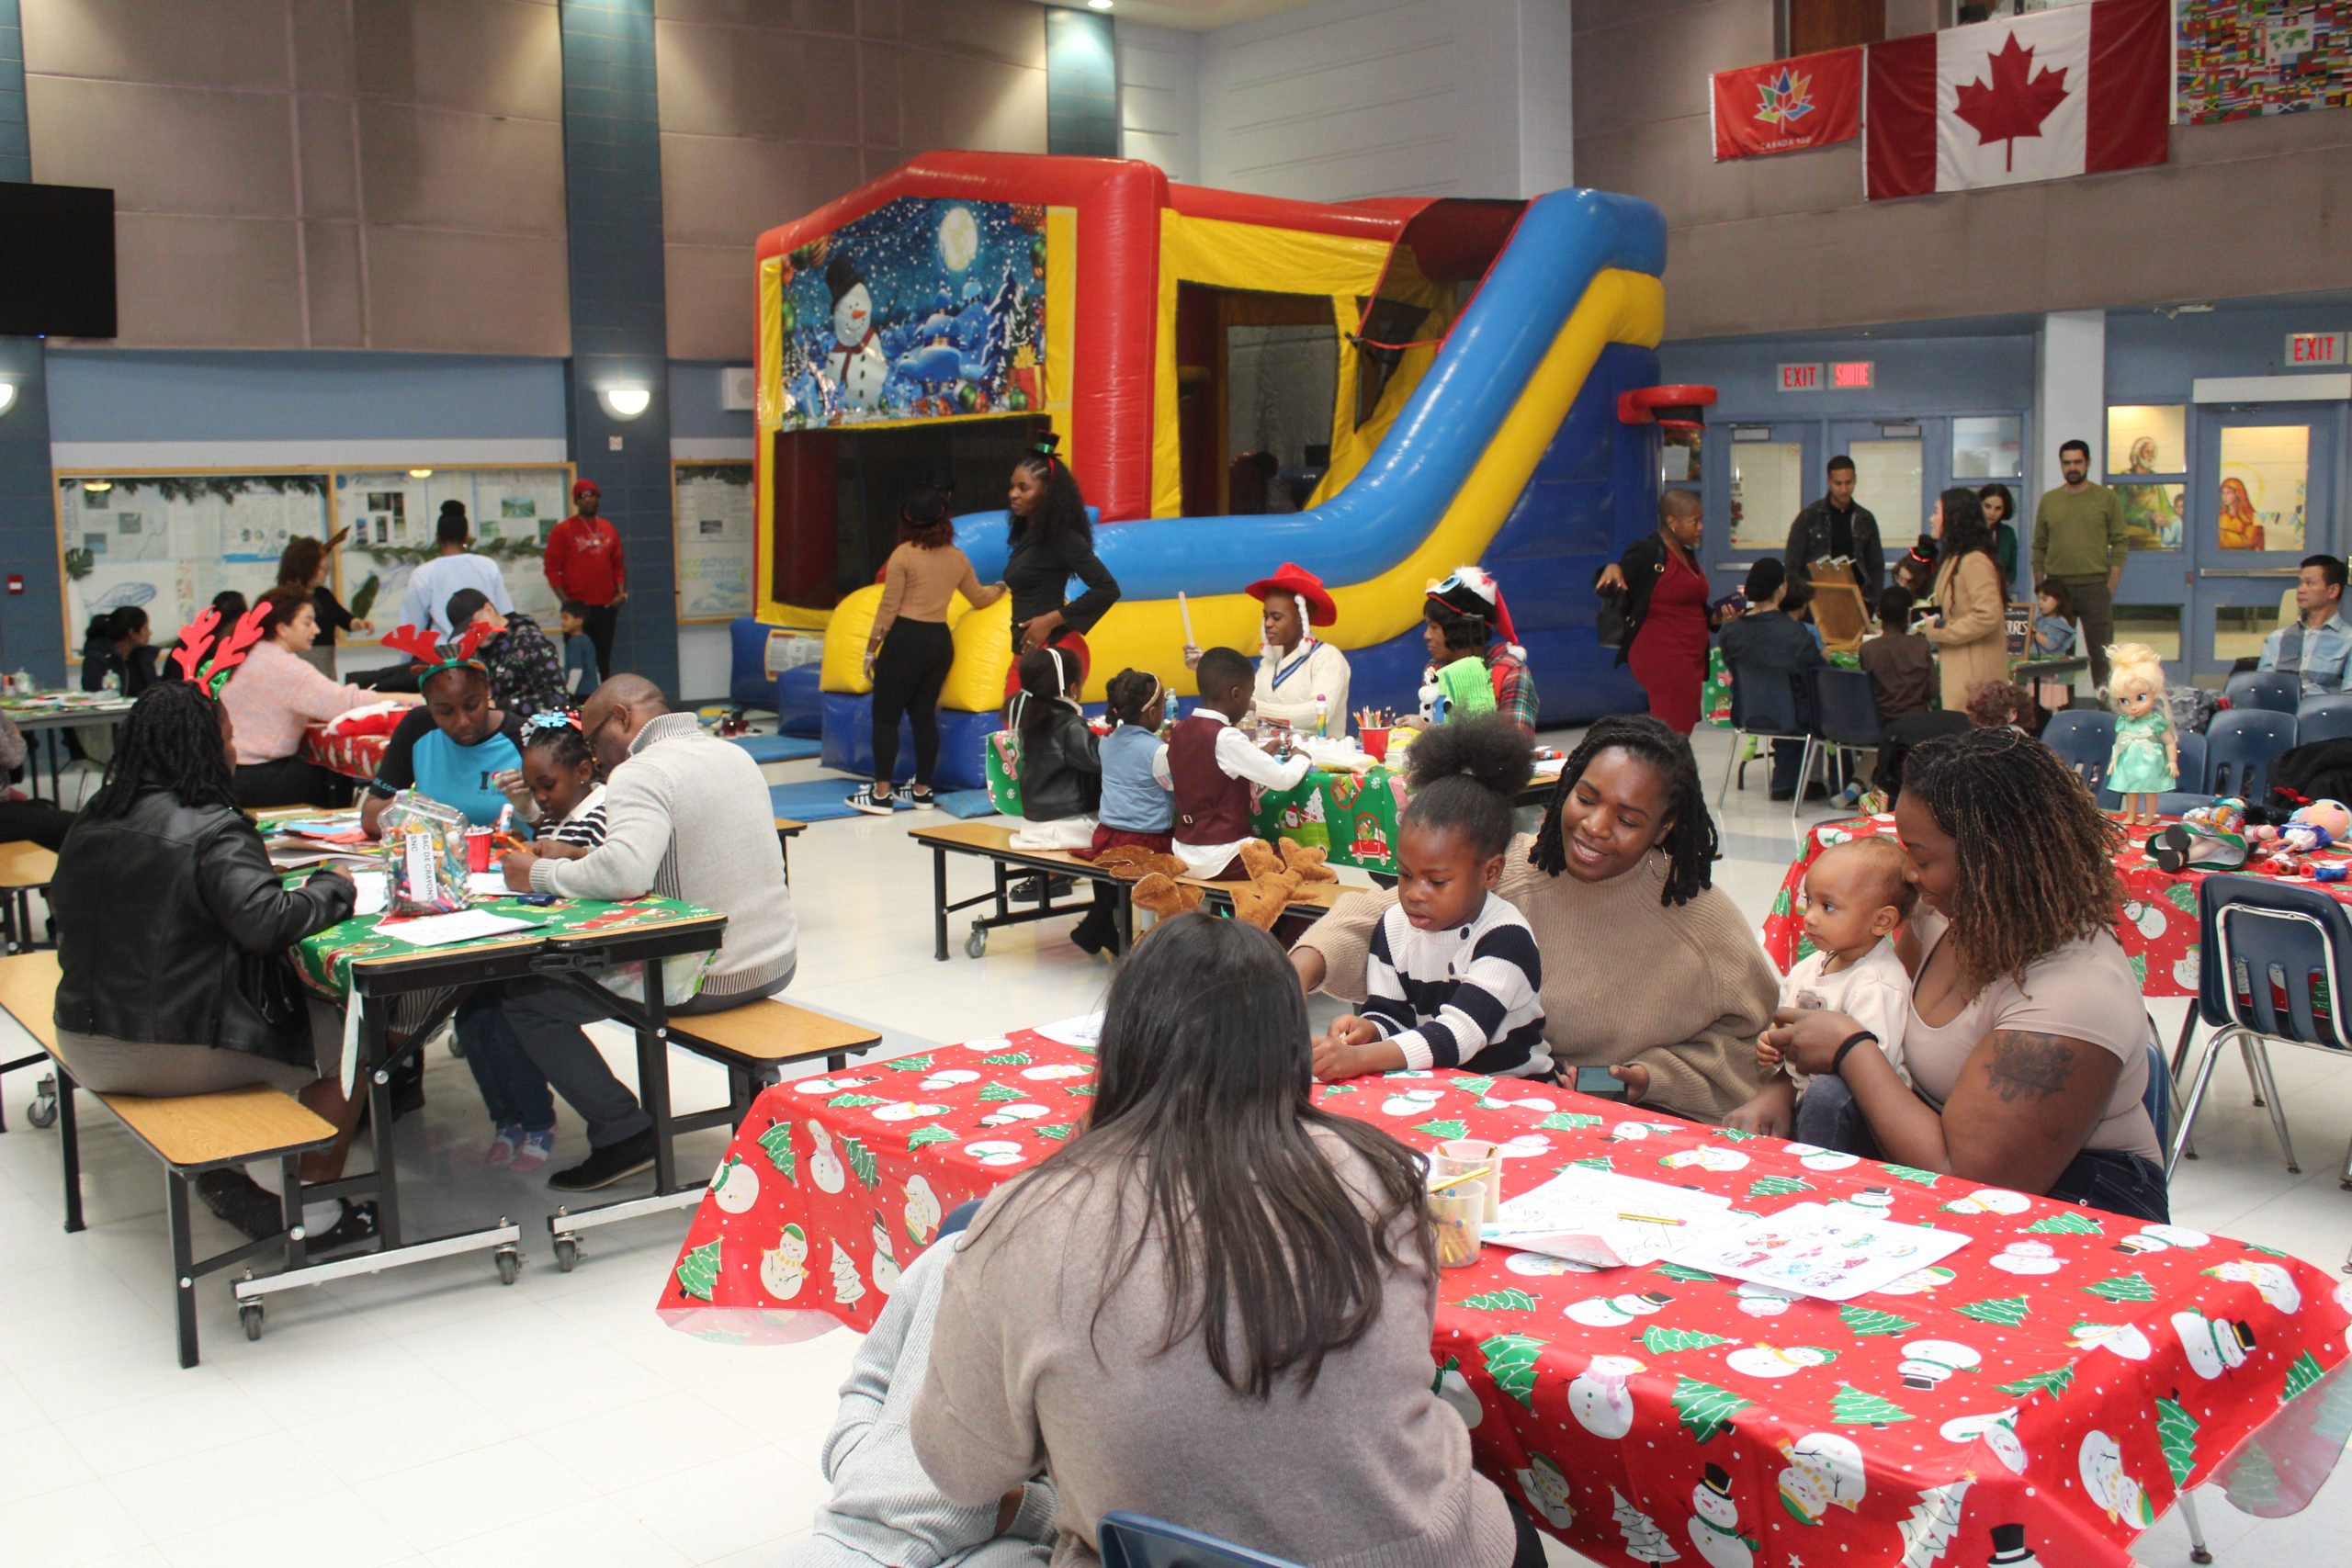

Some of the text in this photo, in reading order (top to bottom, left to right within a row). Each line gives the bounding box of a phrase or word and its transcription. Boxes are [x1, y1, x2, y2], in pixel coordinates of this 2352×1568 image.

[1761, 139, 1793, 149] CANADA
[2294, 336, 2335, 361] EXIT
[1784, 363, 1871, 388] EXIT SORTIE
[424, 852, 431, 862] DE
